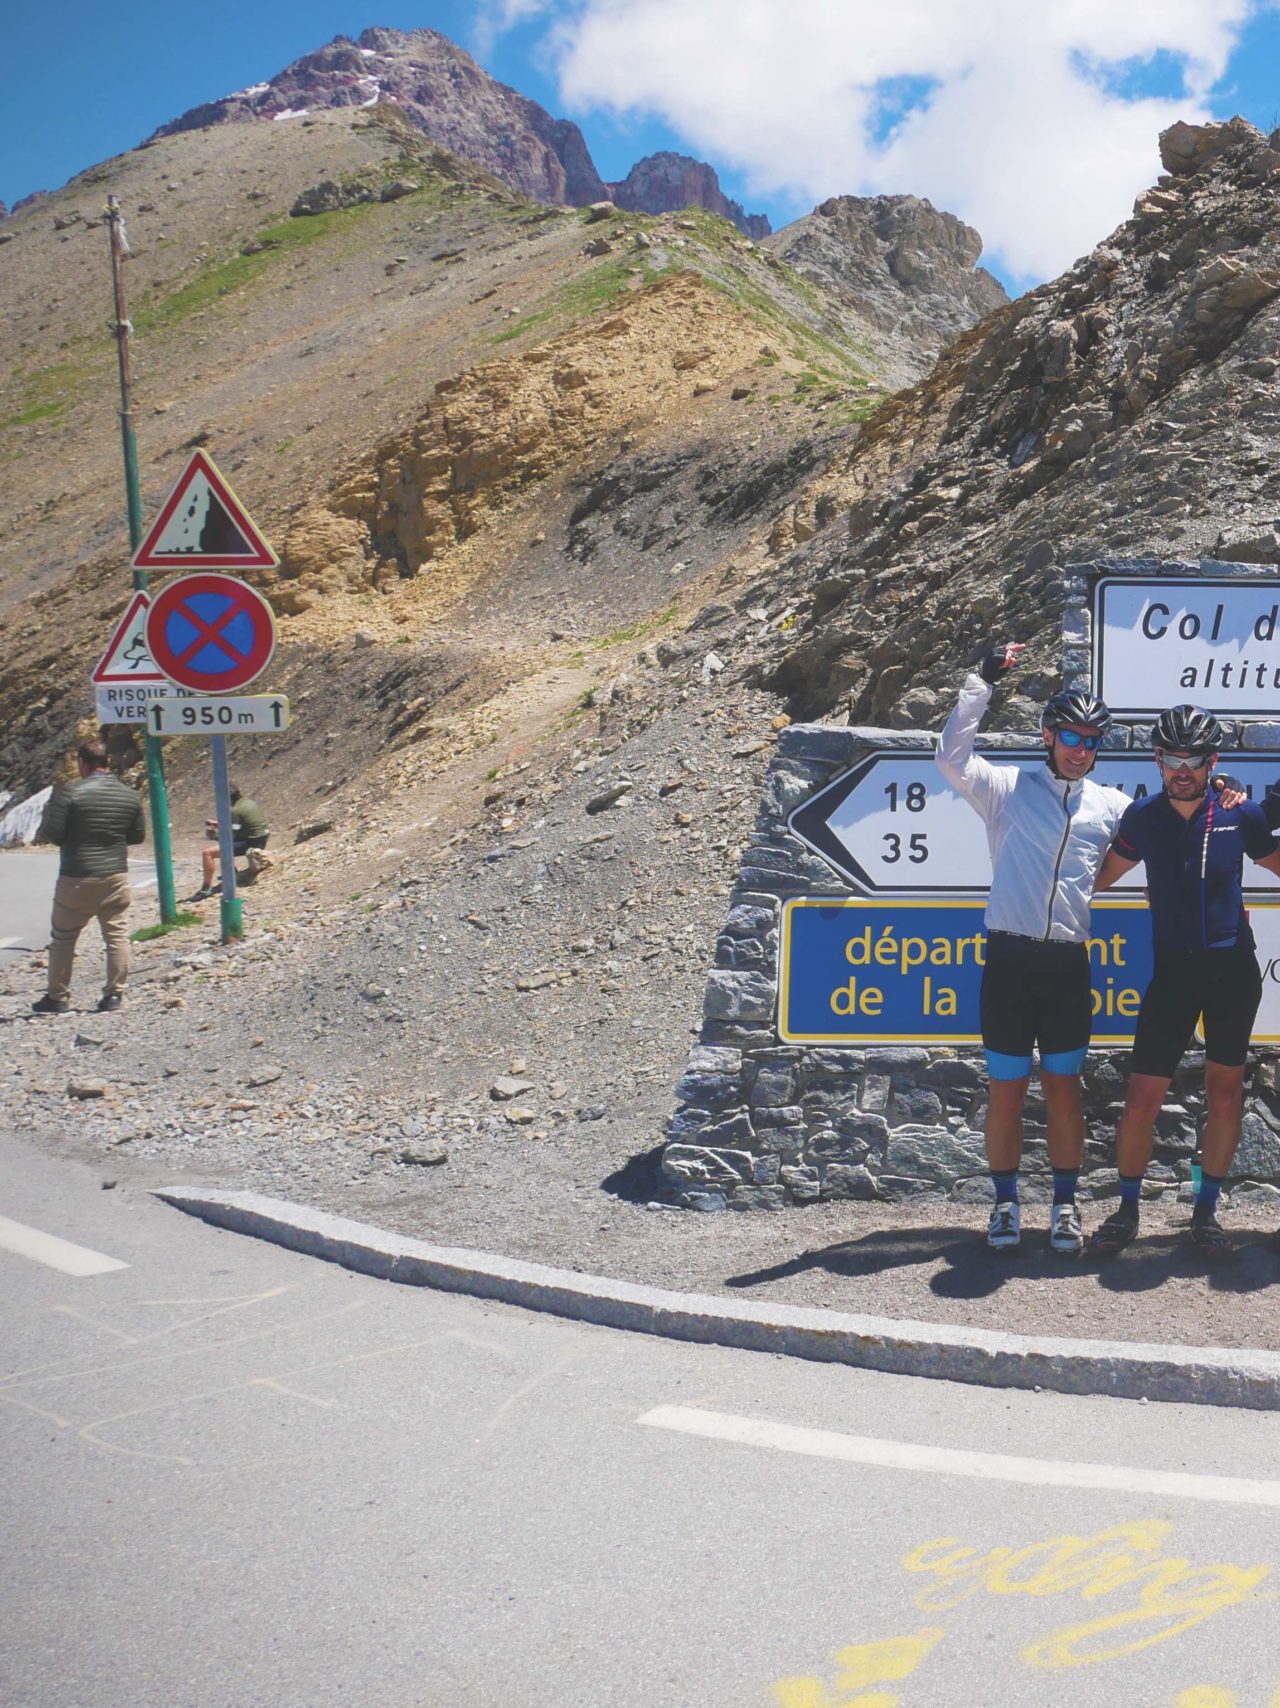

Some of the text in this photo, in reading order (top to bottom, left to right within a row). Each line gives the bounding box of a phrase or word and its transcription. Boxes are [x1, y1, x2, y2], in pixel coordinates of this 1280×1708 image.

[1141, 603, 1225, 641] Col
[181, 705, 255, 726] 950 m
[883, 781, 927, 813] 18
[880, 833, 929, 864] 35
[829, 976, 884, 1016] de
[922, 976, 958, 1016] la
